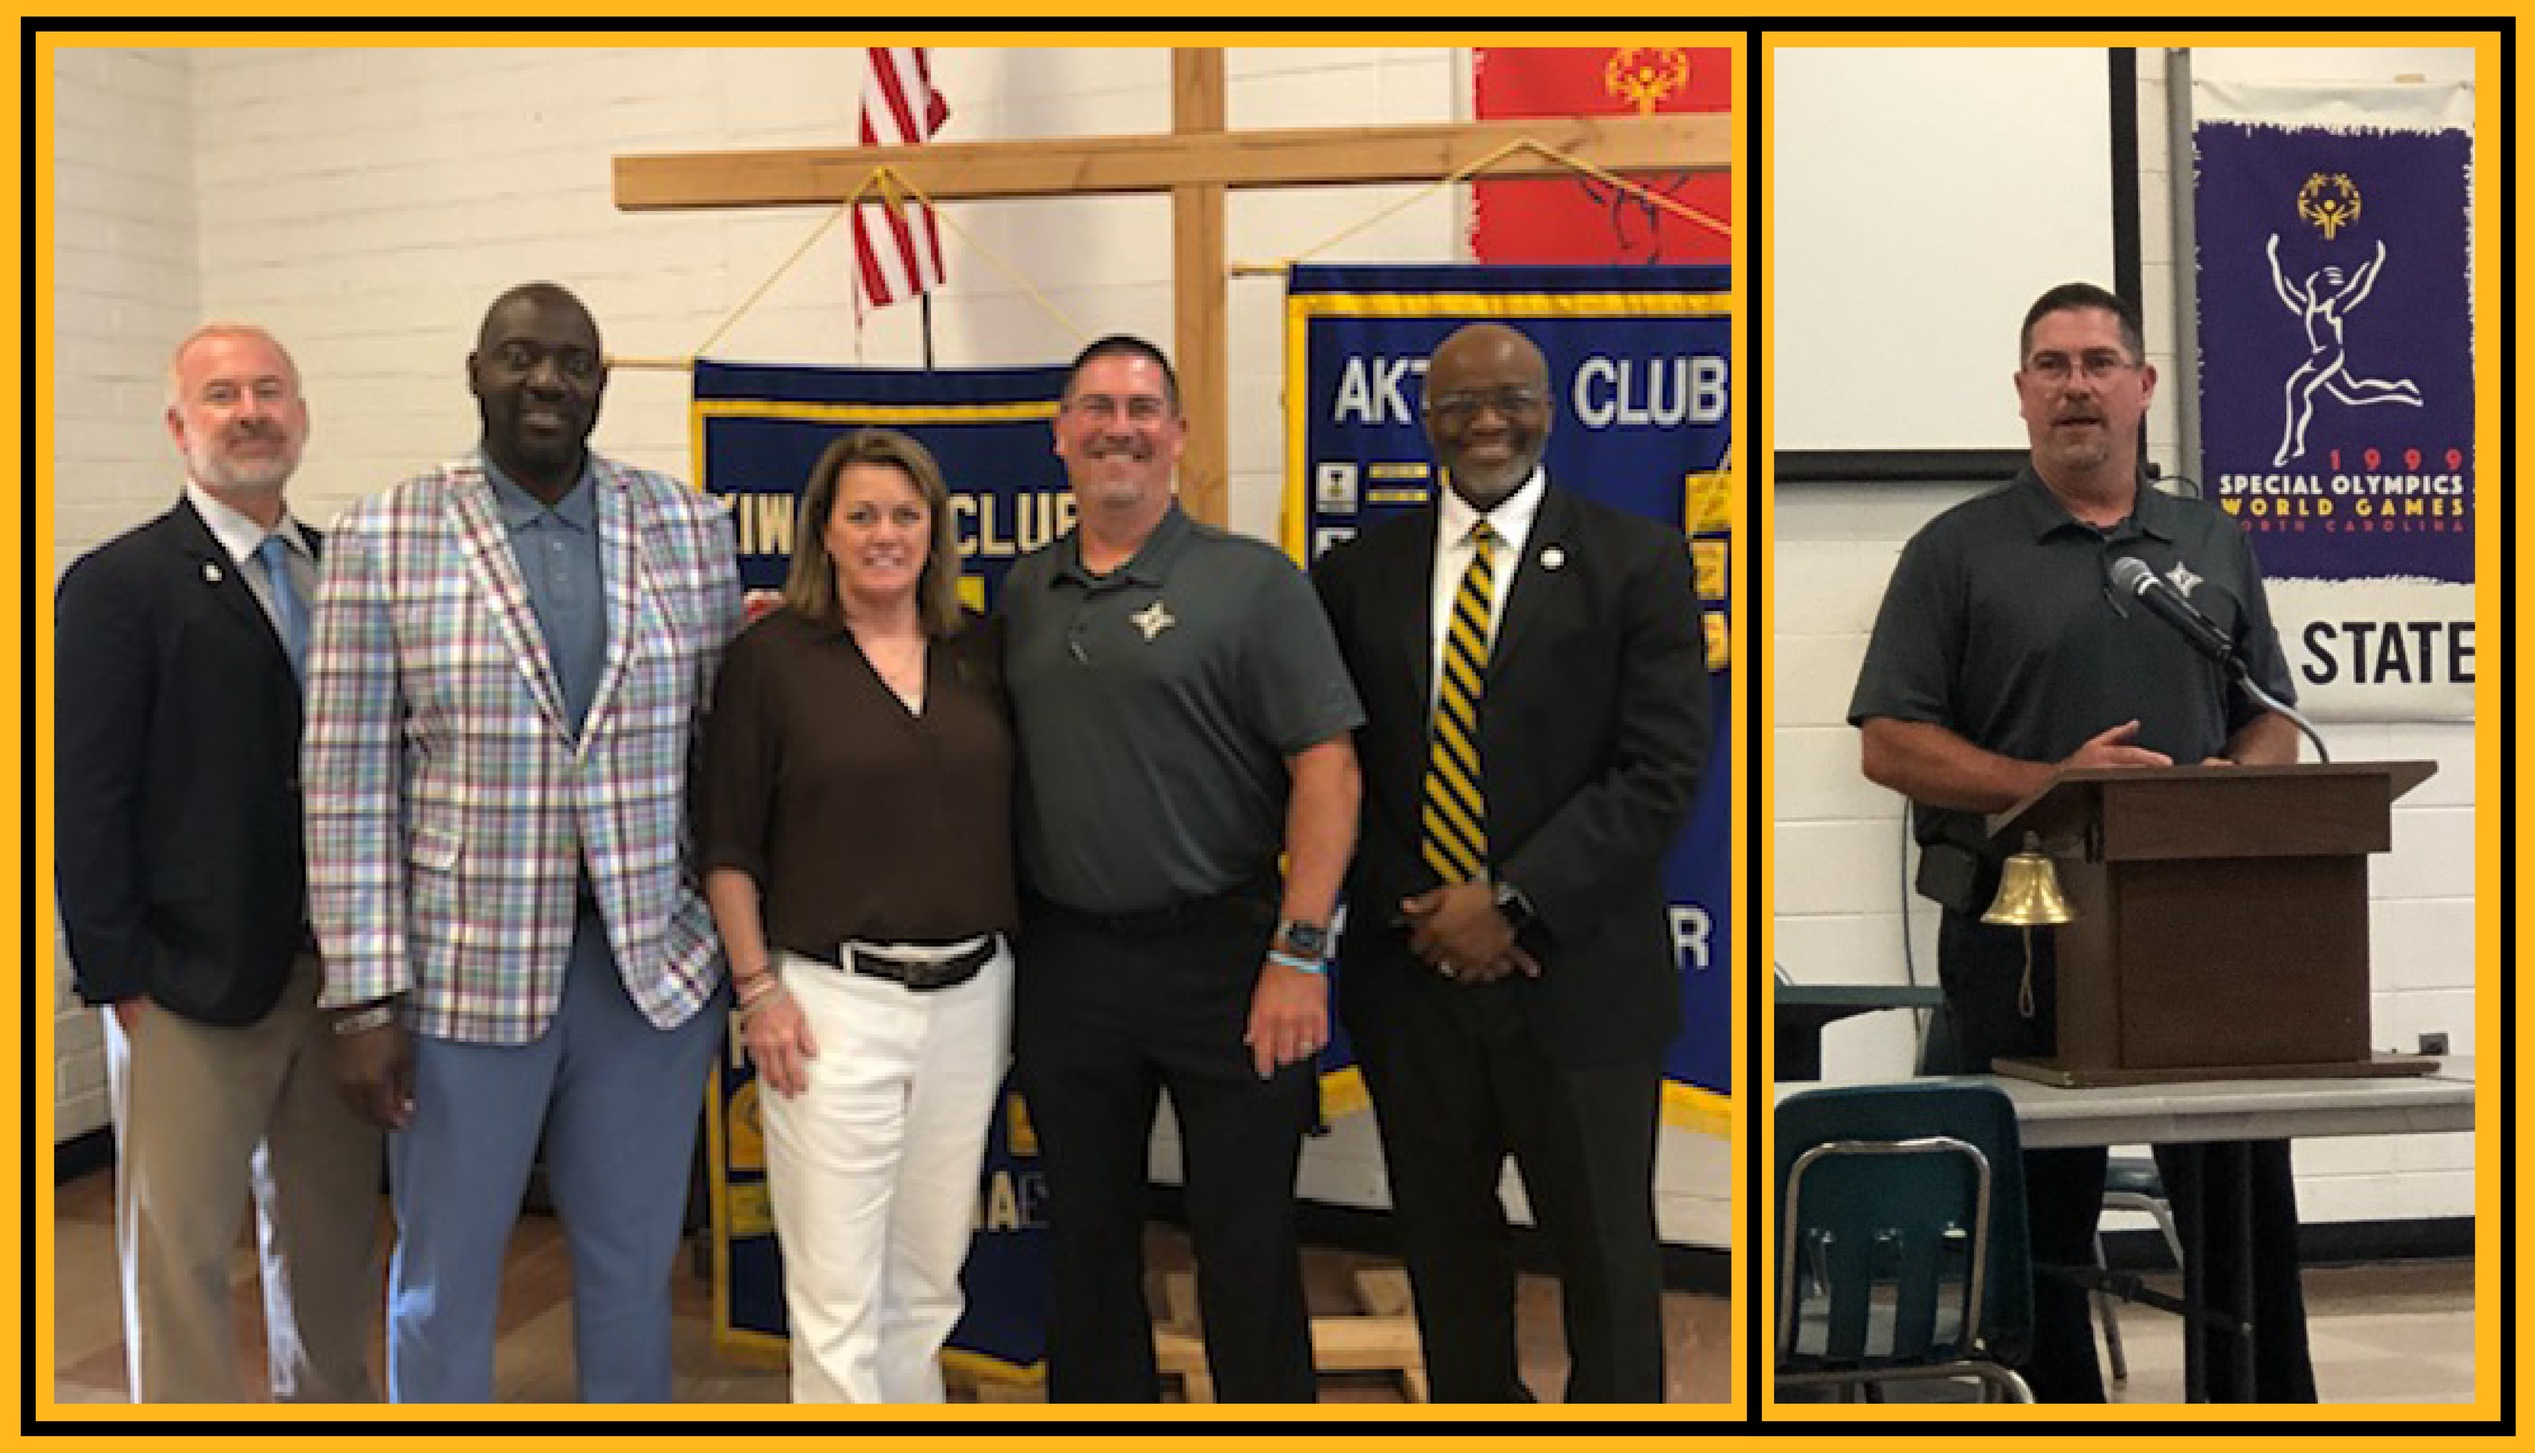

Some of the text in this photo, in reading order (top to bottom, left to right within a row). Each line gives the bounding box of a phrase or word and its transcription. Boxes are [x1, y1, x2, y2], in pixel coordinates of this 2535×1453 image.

[1574, 356, 1727, 426] CLUB
[2331, 449, 2462, 470] 1999
[2219, 474, 2463, 494] SPECIAL OLYMPICS
[2221, 498, 2464, 517] WORLD GAMES
[2241, 519, 2463, 532] ORTH CAROLINA
[2302, 621, 2475, 684] STATE
